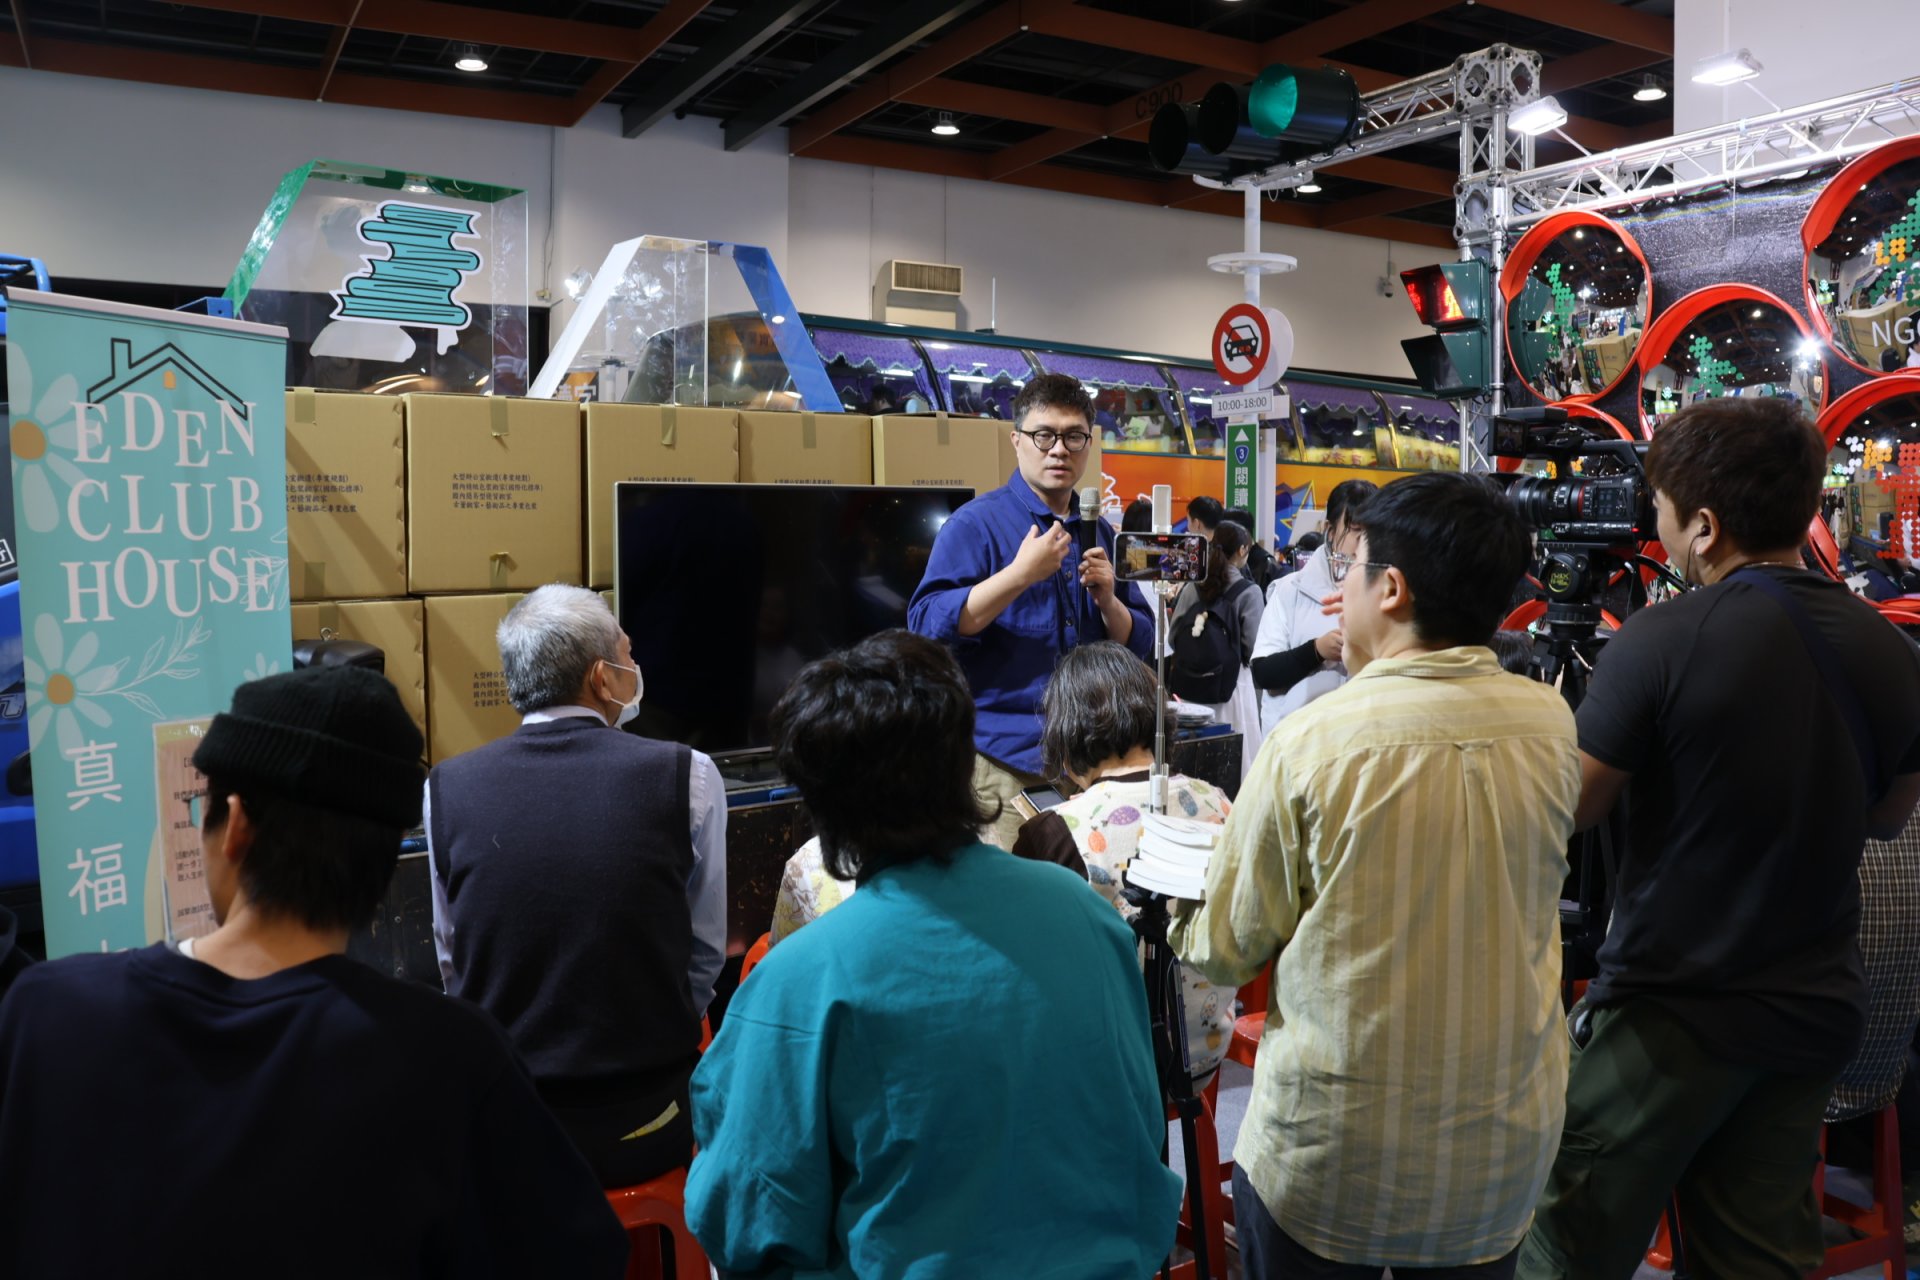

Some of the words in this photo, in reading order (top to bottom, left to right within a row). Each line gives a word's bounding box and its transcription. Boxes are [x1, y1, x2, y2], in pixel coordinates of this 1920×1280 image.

[1871, 316, 1920, 348] NG
[1217, 396, 1267, 412] 10:00-18:00
[70, 391, 257, 467] EDEN
[1238, 448, 1245, 460] 3
[67, 475, 263, 542] CLUB
[60, 547, 275, 624] HOUSE
